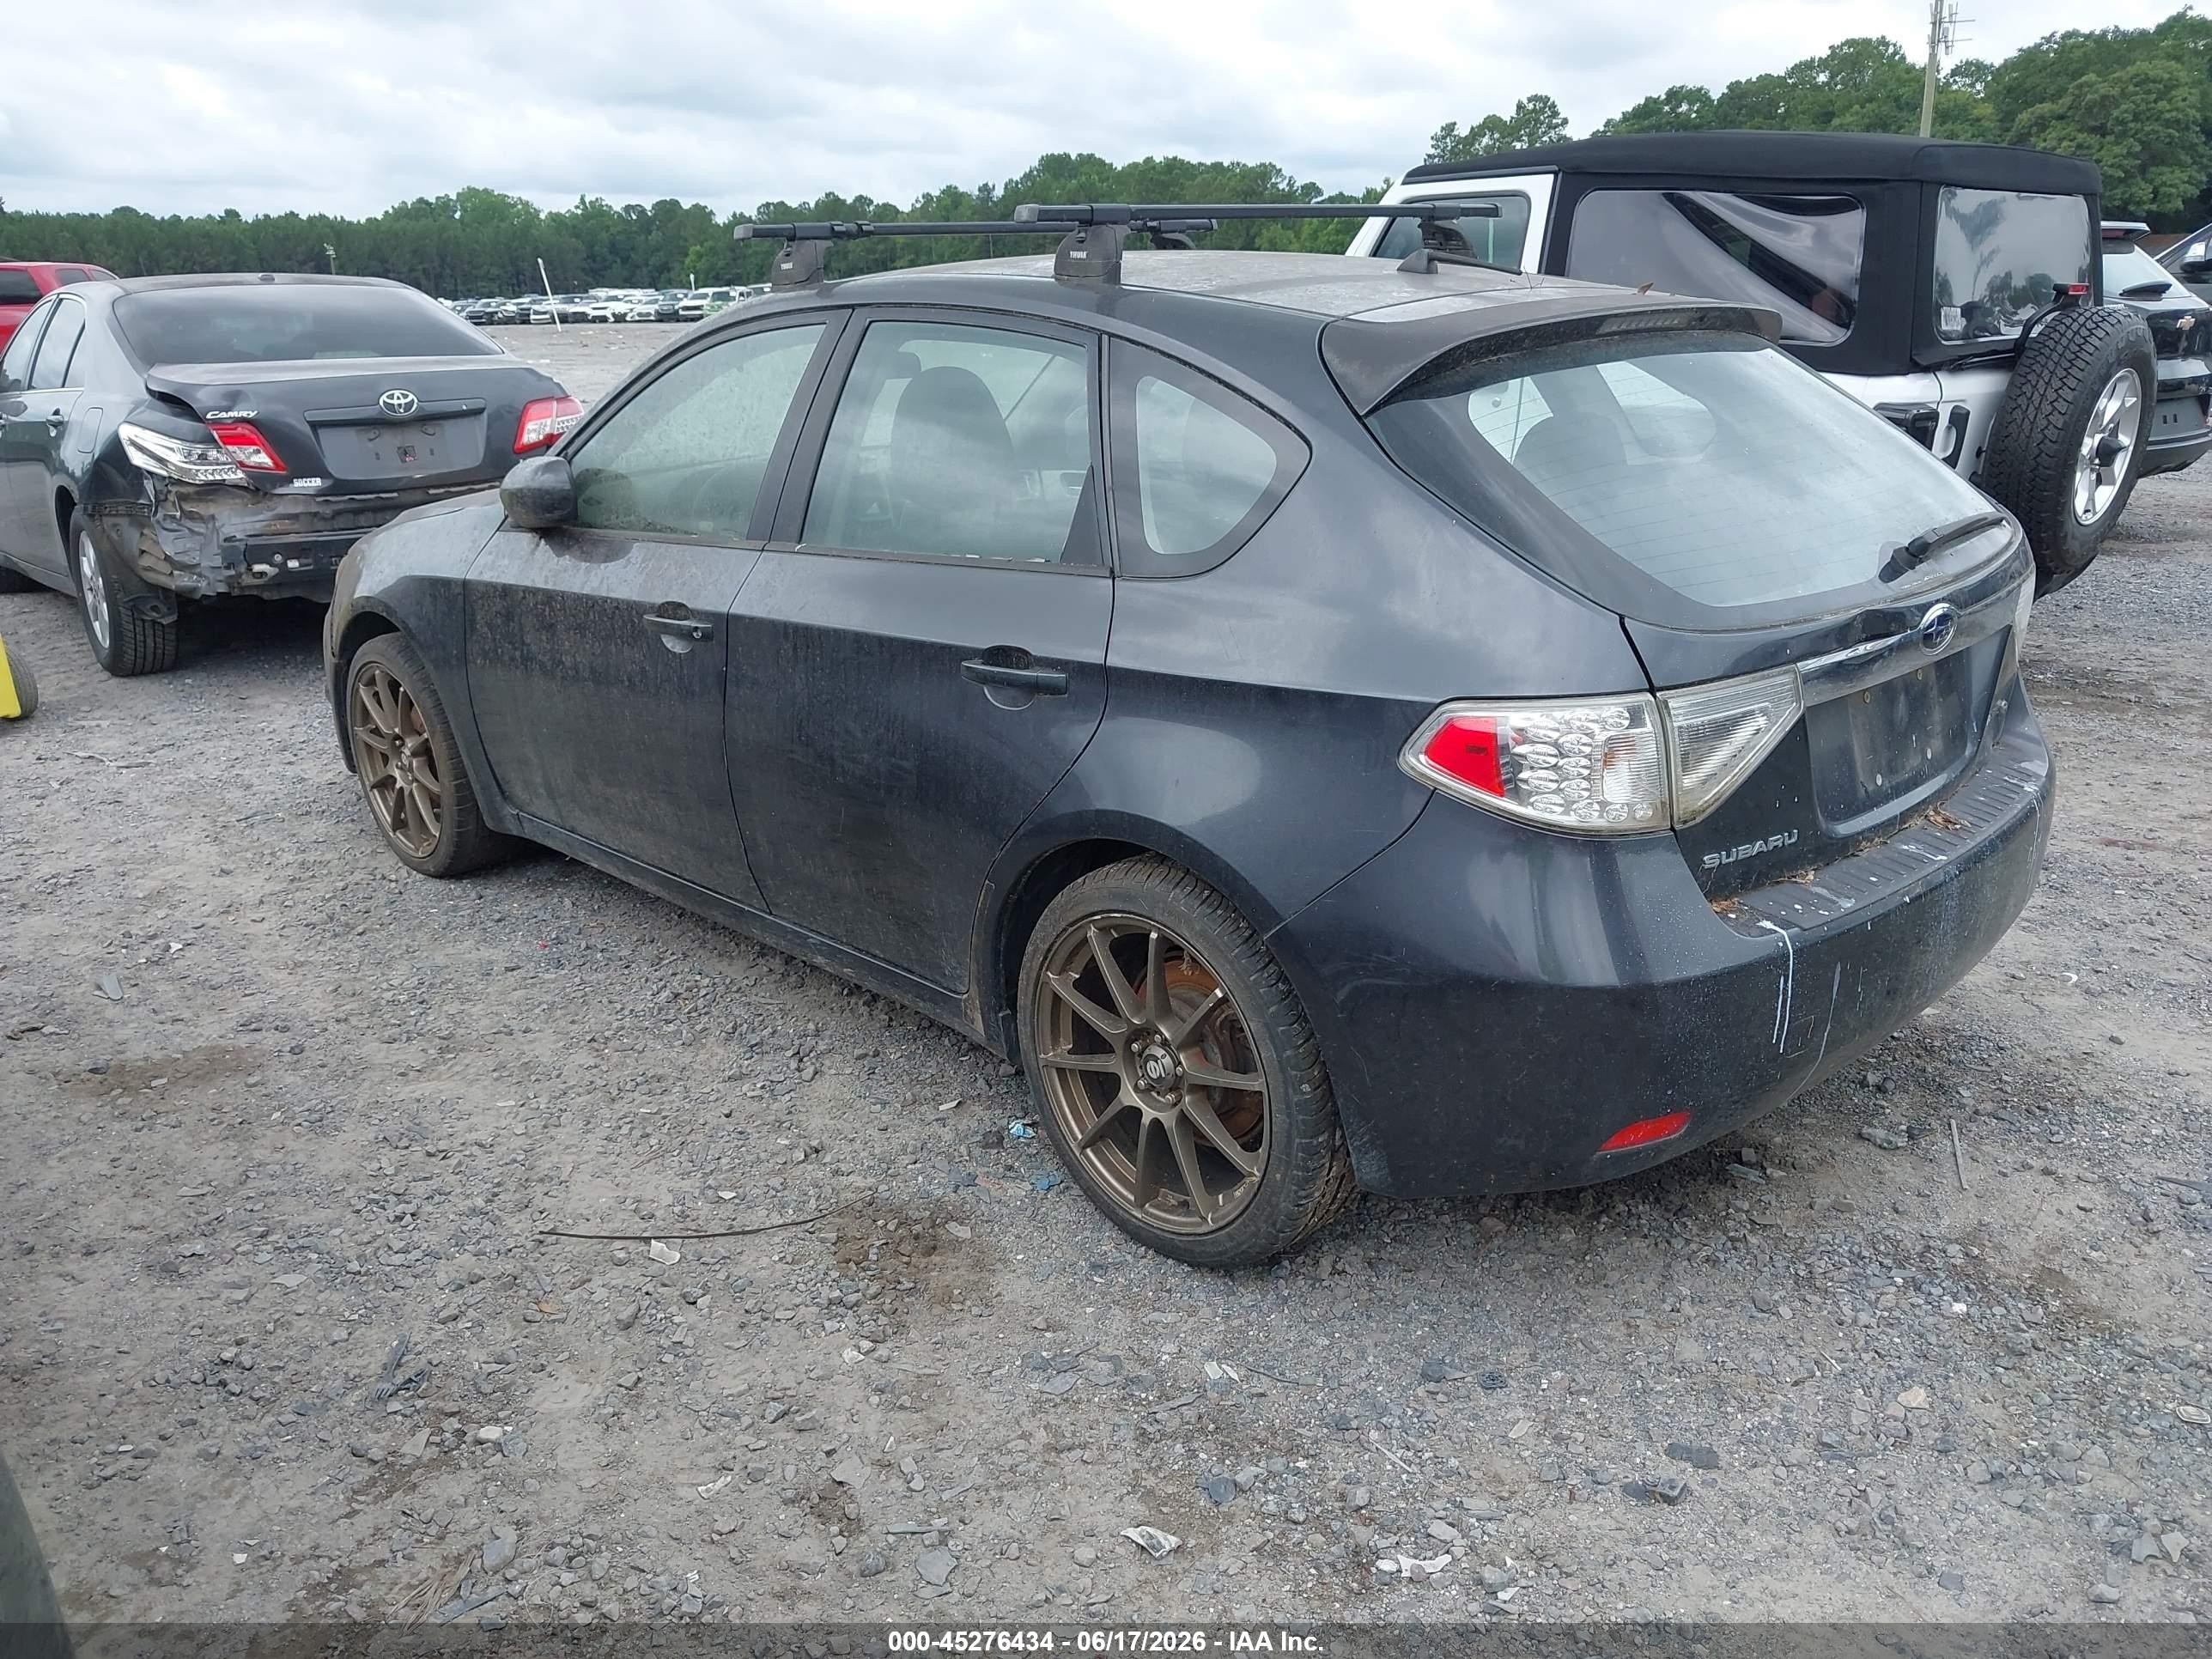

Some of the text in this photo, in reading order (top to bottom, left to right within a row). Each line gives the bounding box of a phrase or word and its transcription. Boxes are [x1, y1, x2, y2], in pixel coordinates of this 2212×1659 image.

[206, 410, 258, 419] CAMRY
[293, 477, 322, 487] SOCCER
[1702, 829, 1799, 870] SUBARU
